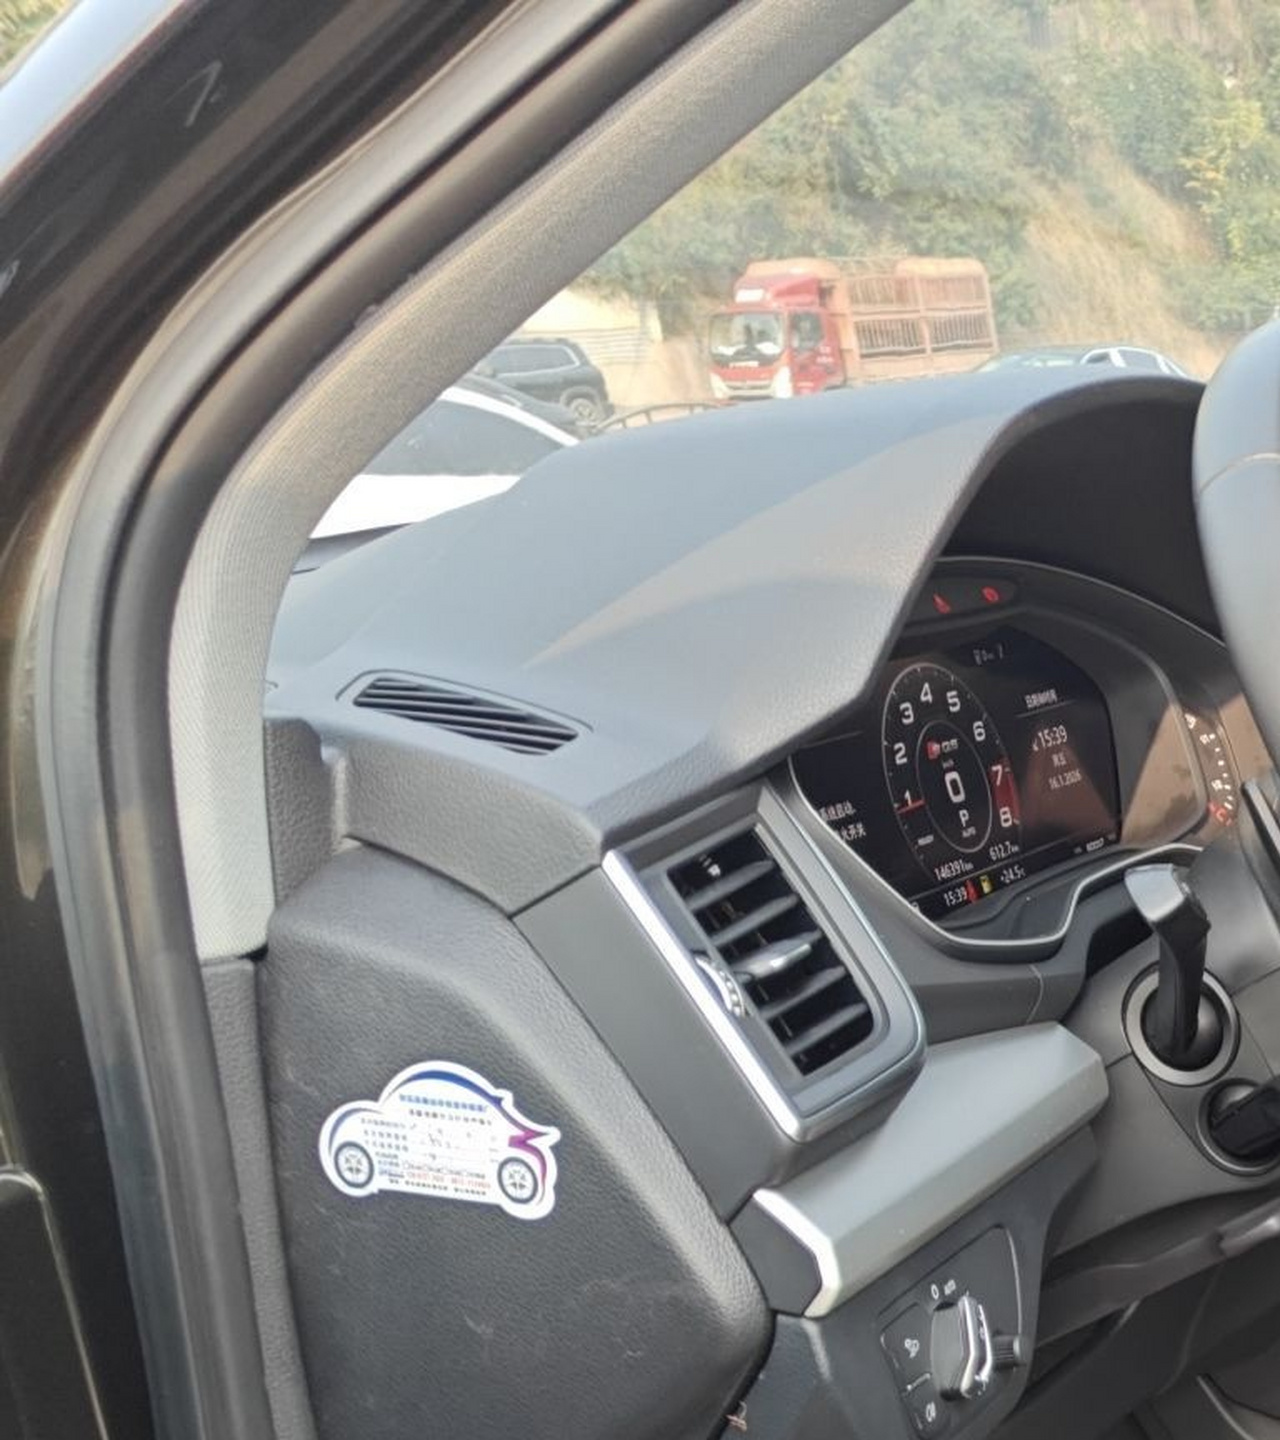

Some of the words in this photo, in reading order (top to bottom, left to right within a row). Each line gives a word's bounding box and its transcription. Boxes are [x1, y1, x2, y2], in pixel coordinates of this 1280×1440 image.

[920, 682, 933, 704] 4
[946, 690, 960, 713] 5
[900, 701, 914, 725] 3
[973, 721, 986, 741] 6
[1038, 725, 1068, 748] 15:39
[893, 742, 908, 765] 2
[944, 770, 966, 803] 0
[991, 764, 1003, 787] 7
[904, 789, 914, 807] 1
[959, 809, 970, 828] P
[1000, 806, 1012, 828] 8
